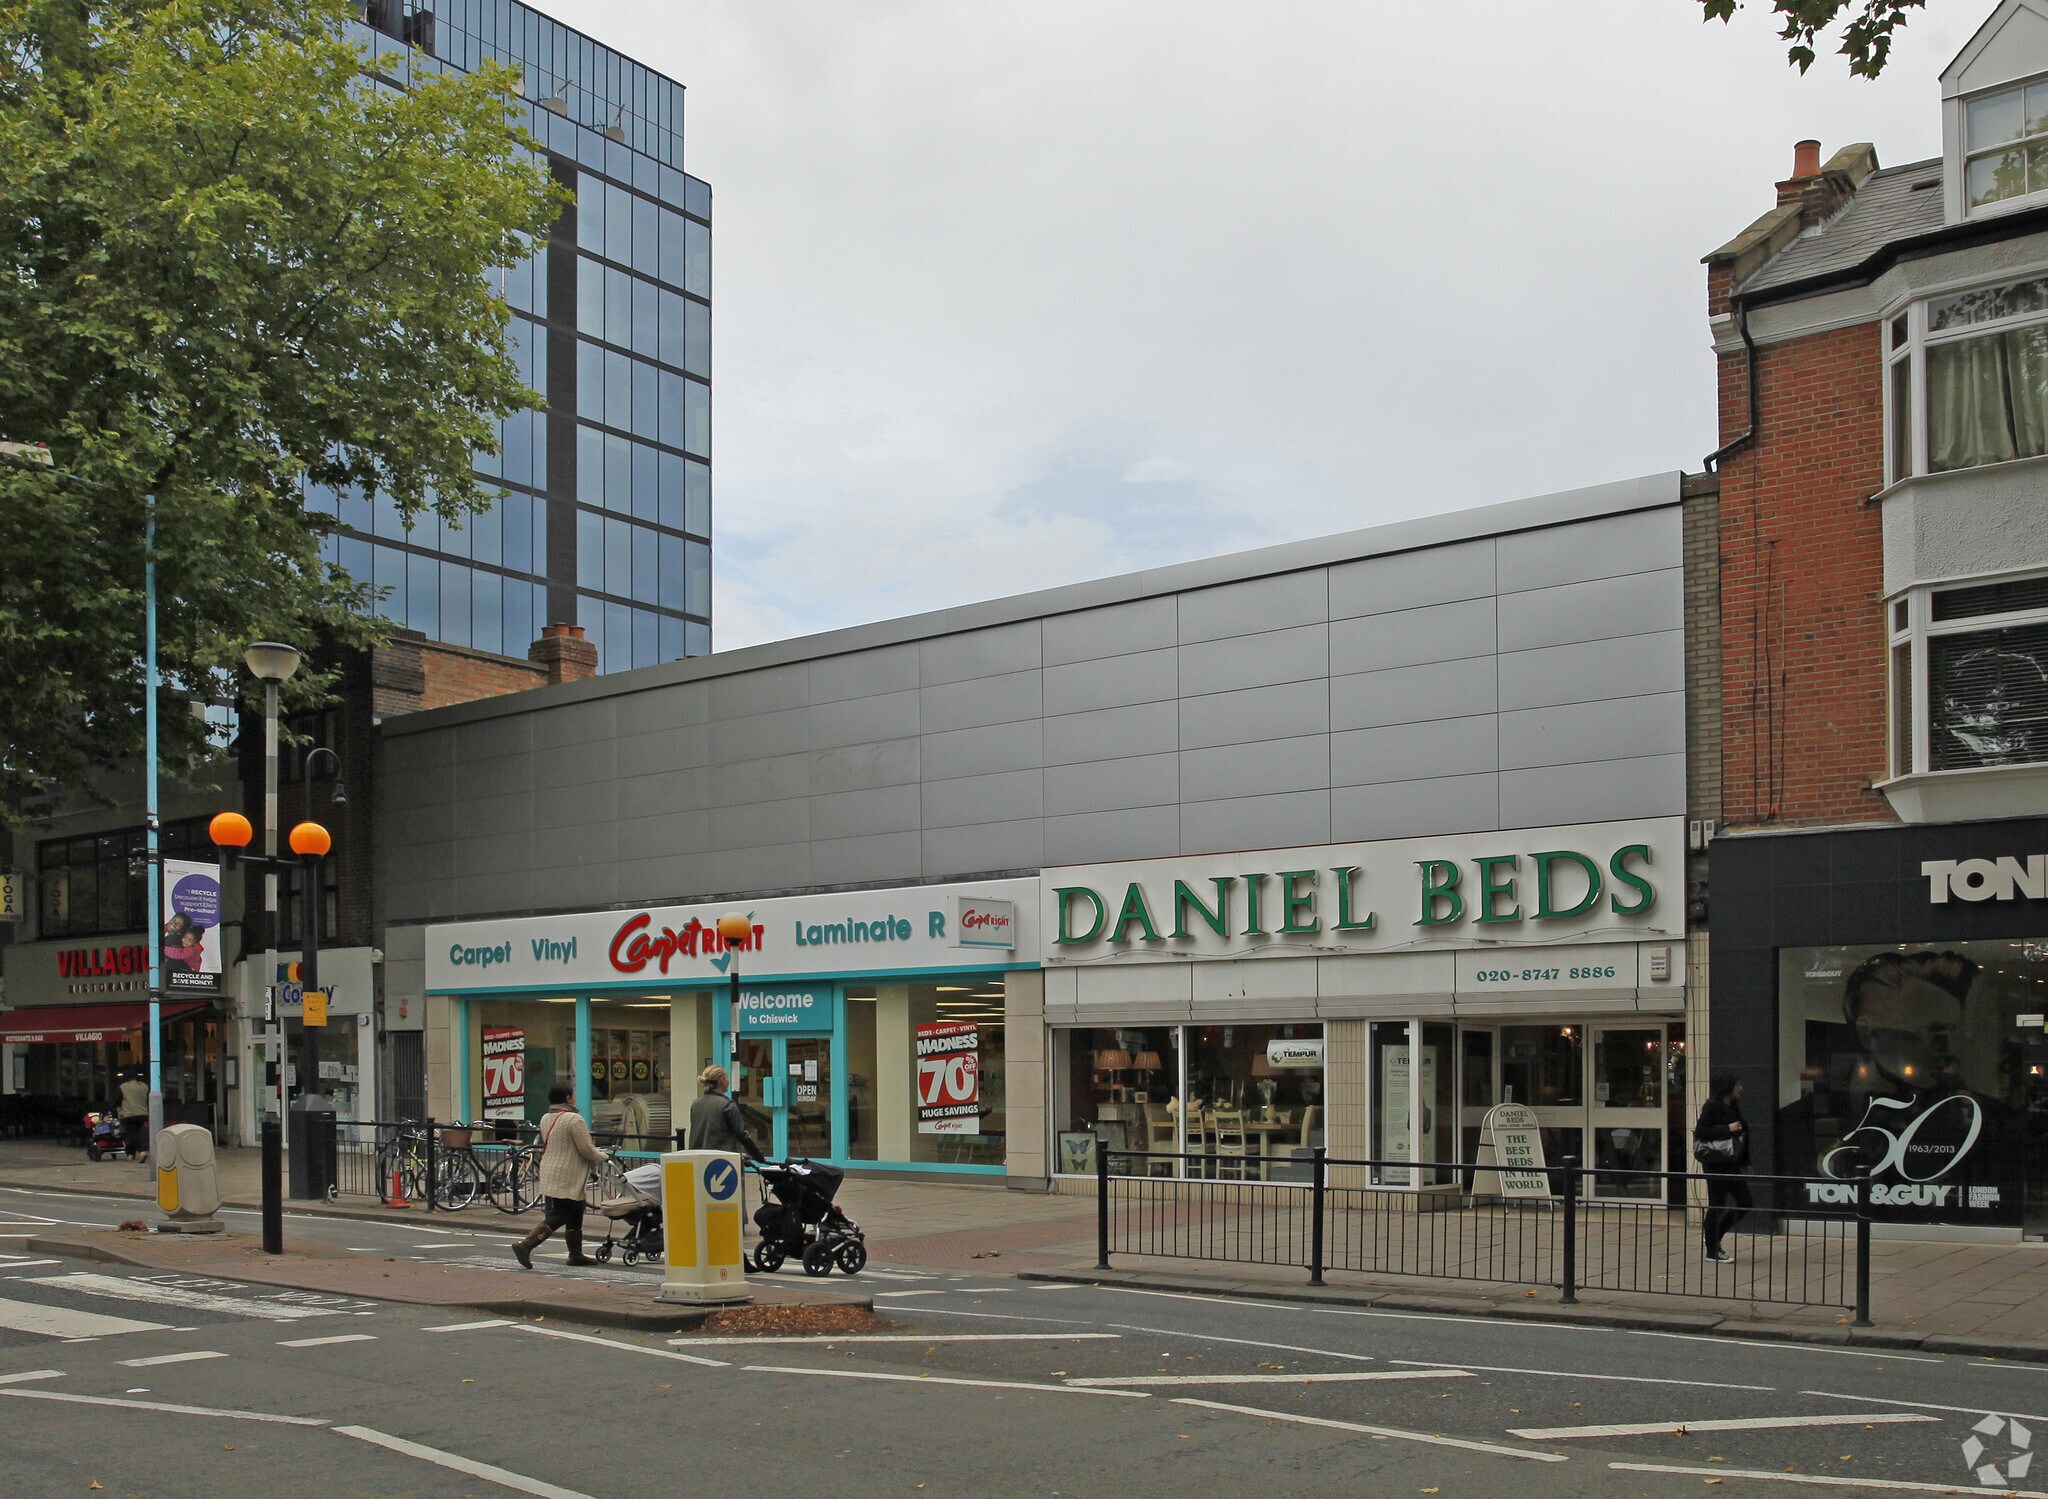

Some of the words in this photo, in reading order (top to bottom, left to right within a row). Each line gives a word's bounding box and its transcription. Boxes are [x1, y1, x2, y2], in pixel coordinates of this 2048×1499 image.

[1921, 854, 2048, 904] TON
[3, 875, 14, 914] YOGA
[1052, 866, 1376, 945] DANIEL
[1412, 844, 1653, 927] BEDS
[796, 914, 912, 946] Laminate
[928, 911, 946, 938] R
[450, 940, 512, 969] Carpet
[531, 936, 578, 965] Vinyl
[56, 946, 149, 977] VILLAGI
[1477, 969, 1559, 982] 020-8747
[1569, 966, 1615, 979] 8886
[738, 992, 814, 1009] Welcome
[749, 1015, 757, 1023] to
[760, 1014, 798, 1023] Chiswick
[935, 1027, 956, 1035] CARPET
[959, 1024, 976, 1032] VINYL
[75, 1032, 102, 1041] VILLAGIO
[483, 1037, 525, 1056] MADNESS
[917, 1033, 978, 1056] MADNESS
[966, 1055, 974, 1064] %
[1283, 1050, 1316, 1058] TEMPUR
[487, 1056, 522, 1095] 70
[921, 1057, 974, 1104] 70
[797, 1085, 817, 1095] OPEN
[502, 1096, 524, 1104] SAVINGS
[922, 1107, 944, 1118] HUGE
[944, 1104, 978, 1116] SAVINGS
[1506, 1135, 1527, 1144] THE
[1823, 1094, 1982, 1182] 50
[1505, 1147, 1531, 1155] BEST
[1909, 1145, 1955, 1154] 1963/2013
[1507, 1158, 1534, 1167] BEDS
[1505, 1170, 1516, 1178] IN
[1505, 1181, 1544, 1190] WORLD
[1968, 1186, 1998, 1194] LONDON
[1806, 1183, 1951, 1207] TON&GUY
[1968, 1194, 2000, 1202] FASHION
